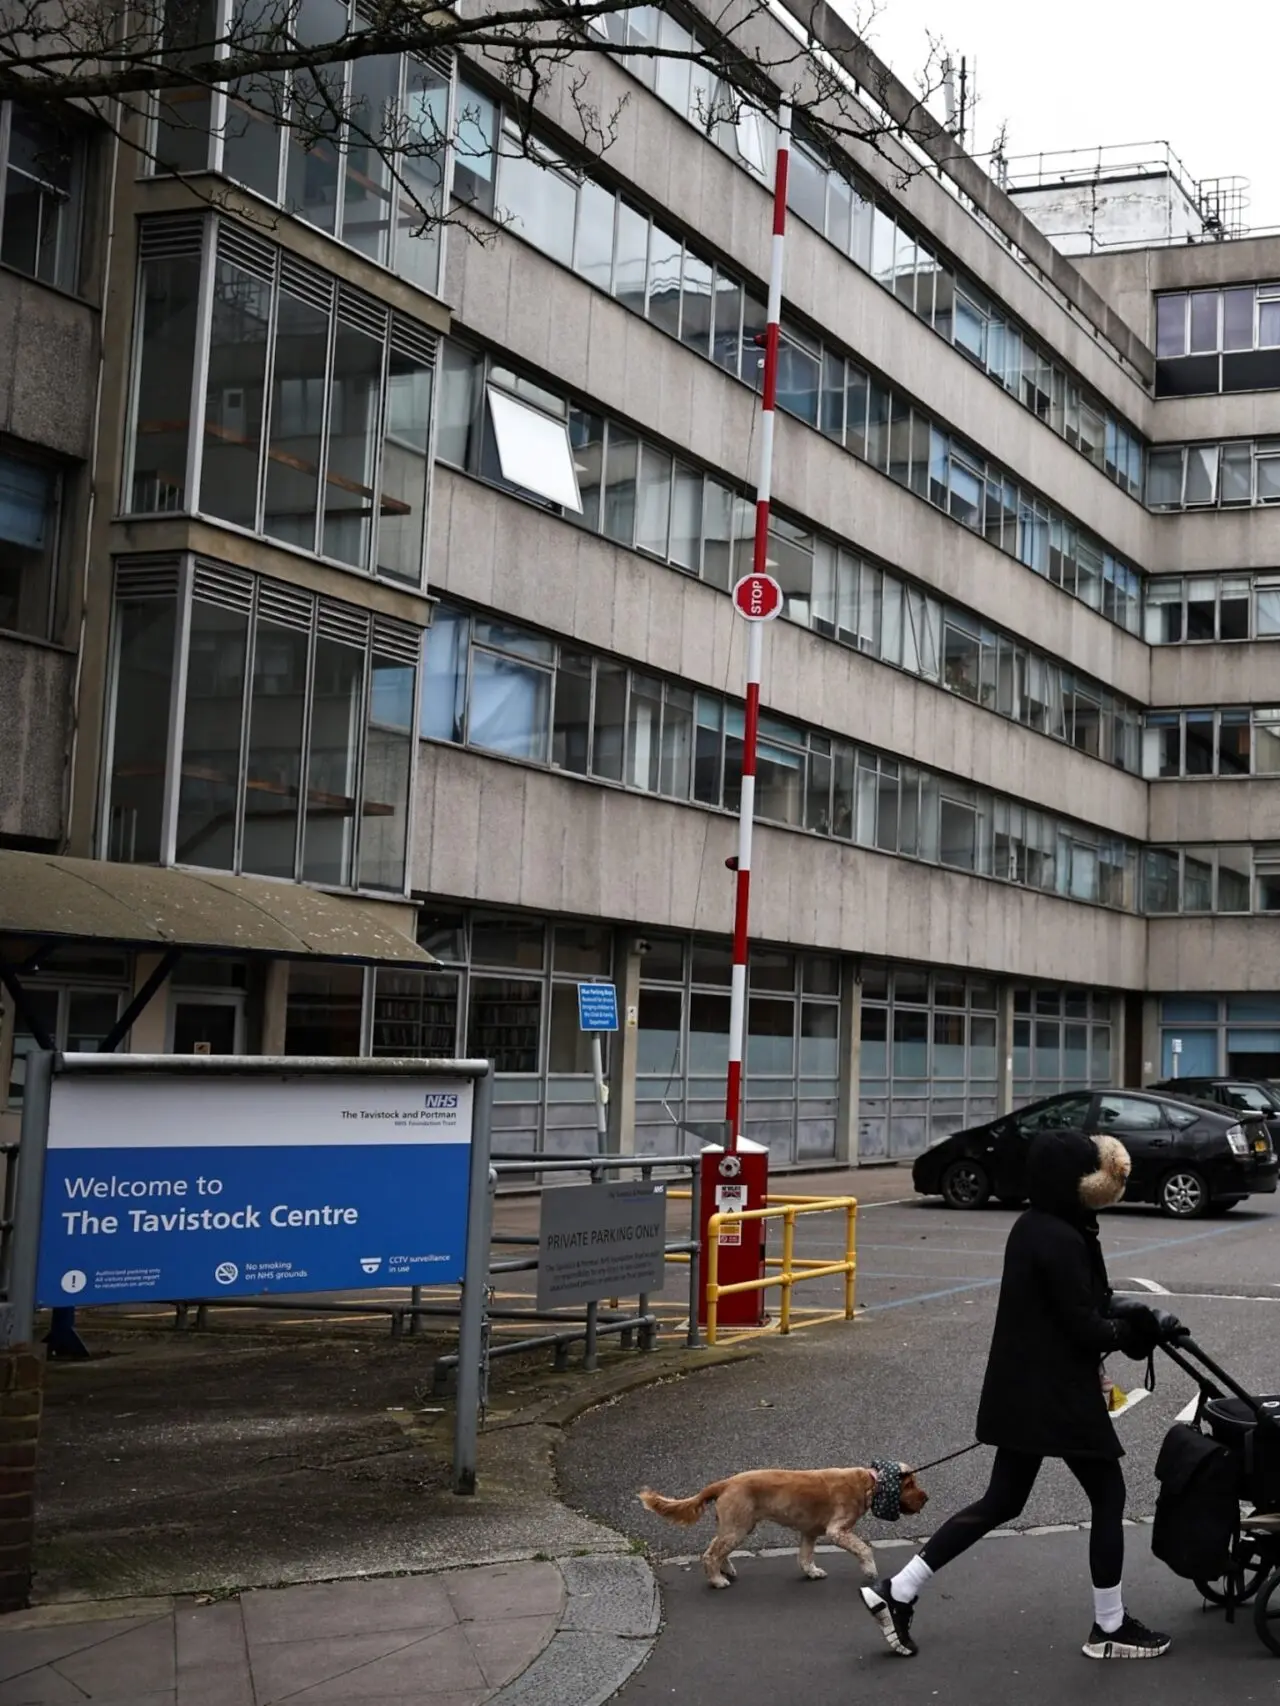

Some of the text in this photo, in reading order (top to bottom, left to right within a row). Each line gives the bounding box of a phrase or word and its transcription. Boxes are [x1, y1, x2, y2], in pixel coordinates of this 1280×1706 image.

[751, 580, 763, 614] STOP
[426, 1095, 457, 1108] NHS
[341, 1110, 457, 1119] The Tavistock and Portman
[64, 1175, 223, 1199] Welcome to
[62, 1203, 358, 1235] The Tavistock Centre
[547, 1223, 661, 1250] PRIVATE PARKING ONLY
[389, 1254, 451, 1264] CCTV surveillance
[245, 1261, 292, 1272] No smoking
[397, 1265, 410, 1273] use
[257, 1271, 274, 1280] NHS
[275, 1269, 308, 1280] grounds
